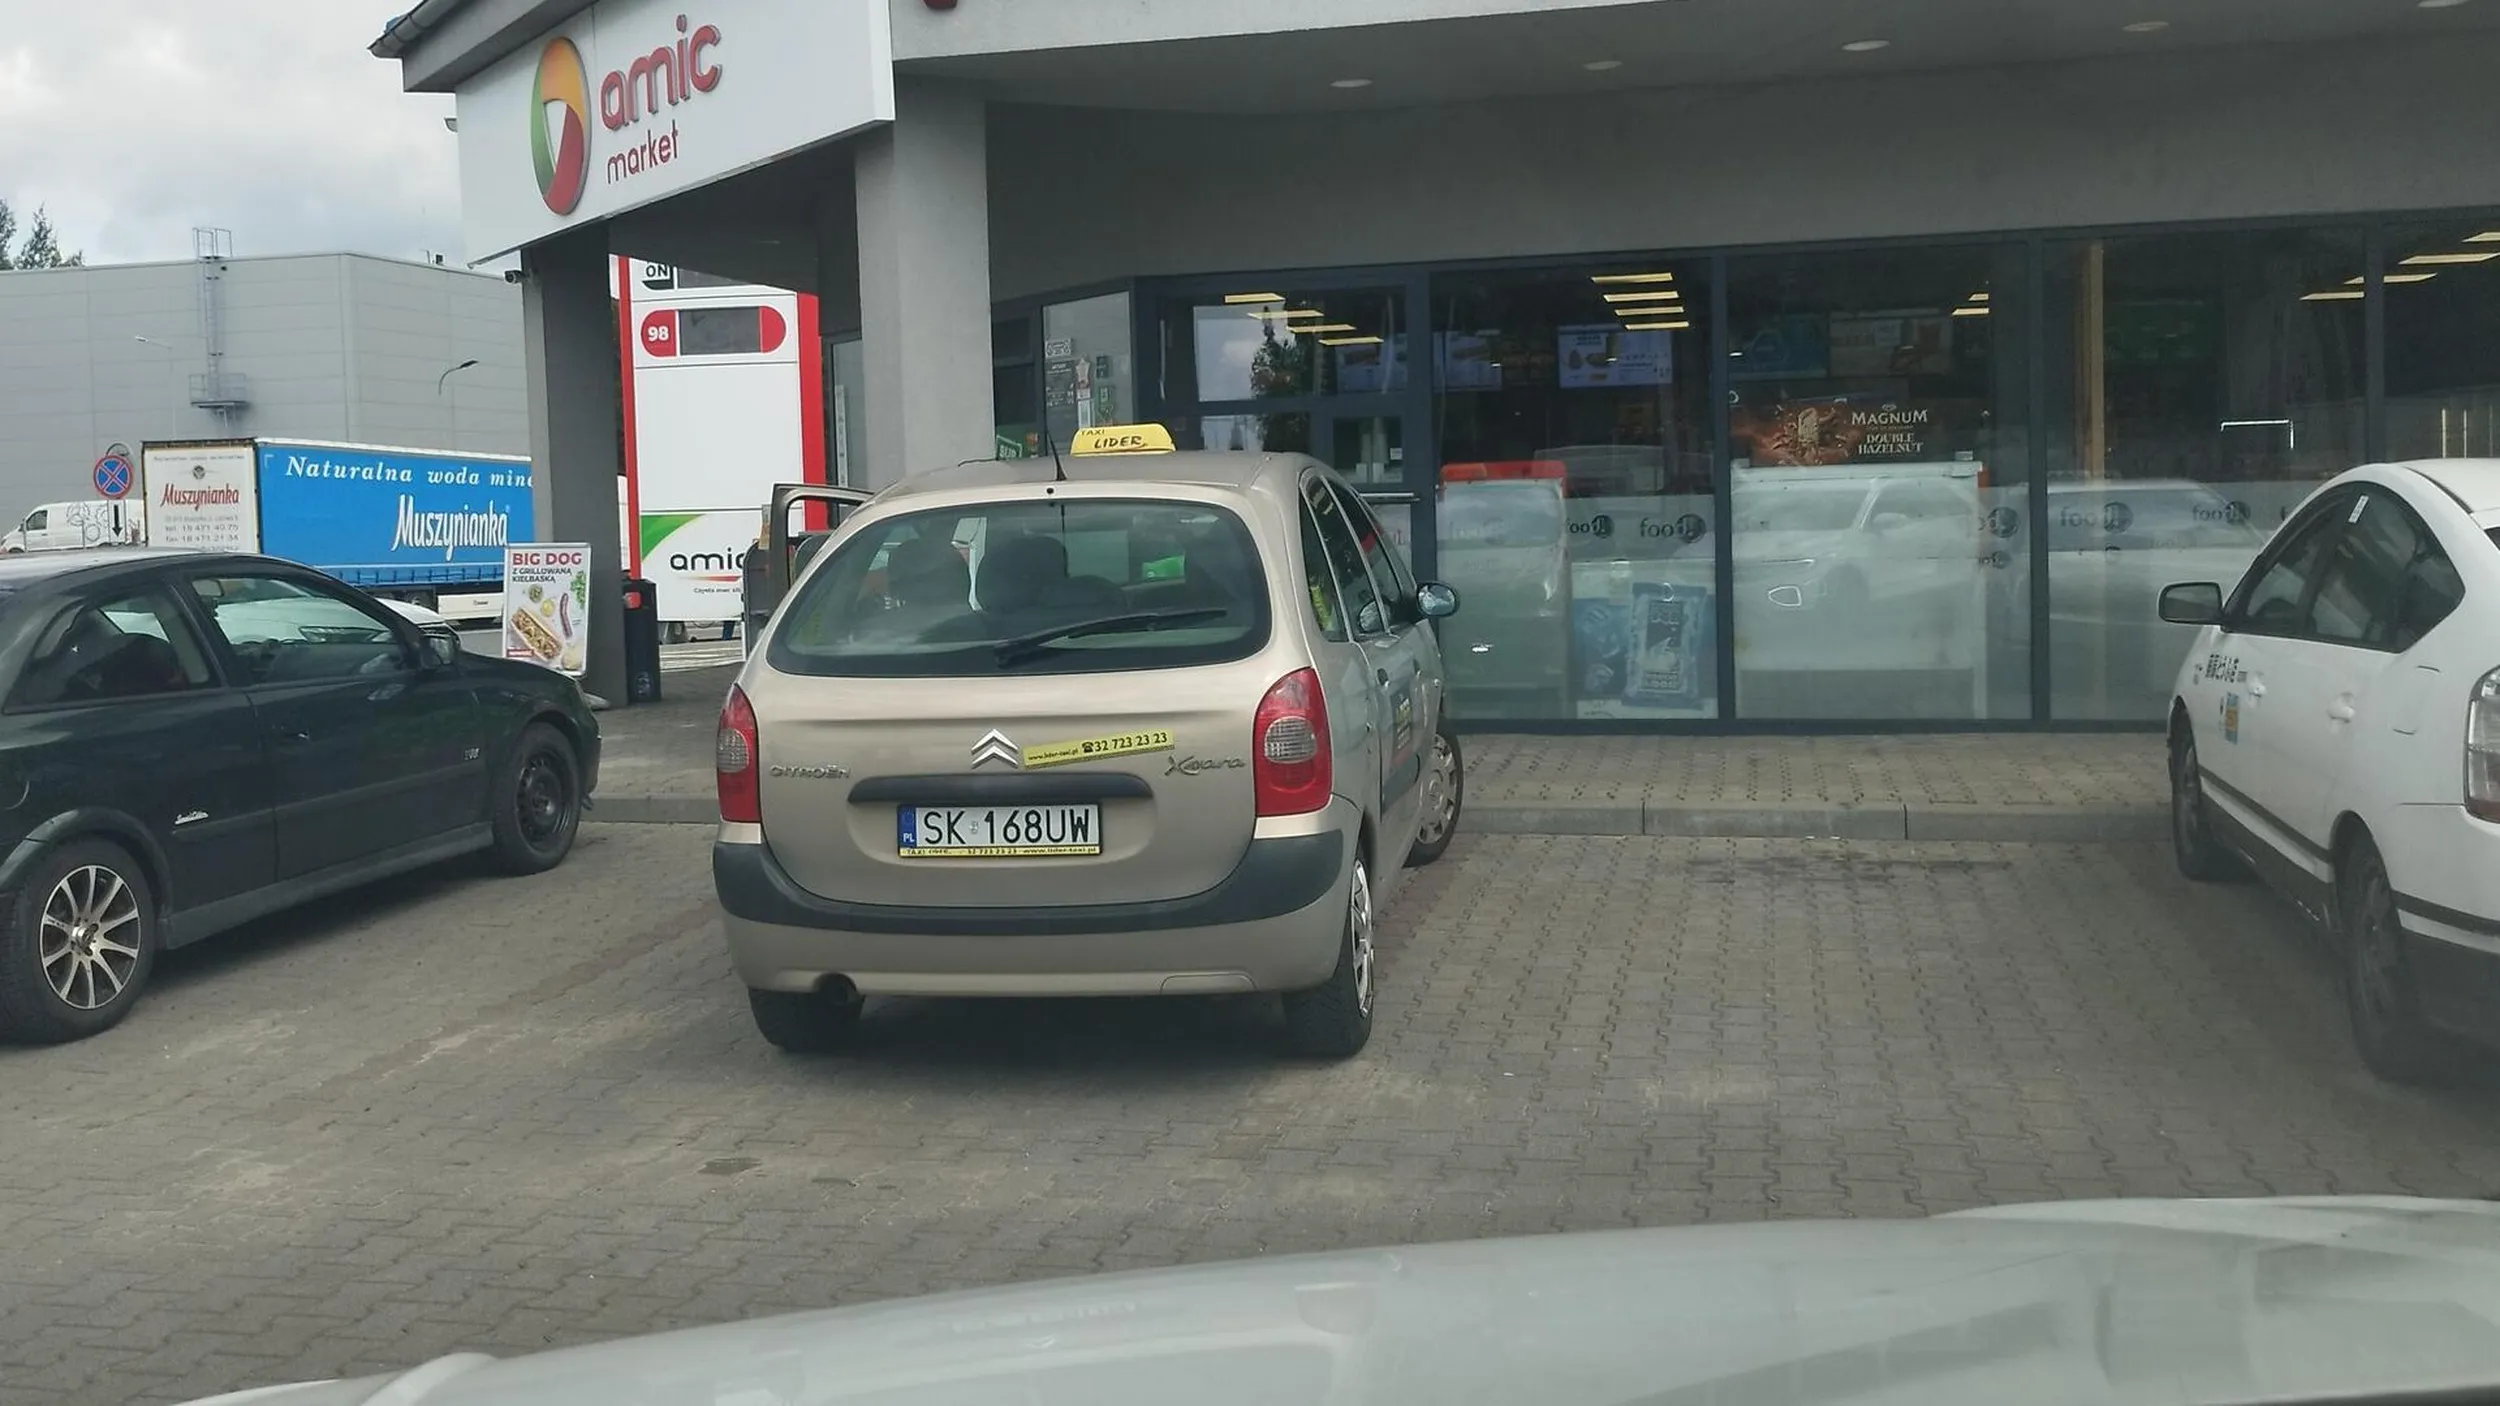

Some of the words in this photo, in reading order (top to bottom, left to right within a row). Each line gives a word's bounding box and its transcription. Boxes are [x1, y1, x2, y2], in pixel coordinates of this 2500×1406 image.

[601, 14, 722, 131] amic
[607, 119, 679, 184] market
[645, 265, 668, 278] ON
[648, 325, 669, 342] 98
[1851, 409, 1928, 425] MAGNUM
[1094, 435, 1143, 449] LIDER
[1866, 432, 1915, 444] DOUBLE
[1858, 442, 1924, 455] HAZELNUT
[286, 455, 413, 483] Naturalna
[427, 466, 480, 485] woda
[160, 482, 239, 512] Muszynianka
[390, 494, 508, 562] Muszynianka
[512, 552, 541, 565] BIG
[546, 552, 582, 565] DOG
[1095, 741, 1109, 752] 32
[1112, 736, 1133, 749] 723
[1135, 734, 1150, 746] 23
[1154, 732, 1168, 744] 23
[903, 832, 915, 843] PL
[924, 811, 966, 844] SK
[984, 808, 1090, 844] 168UW
